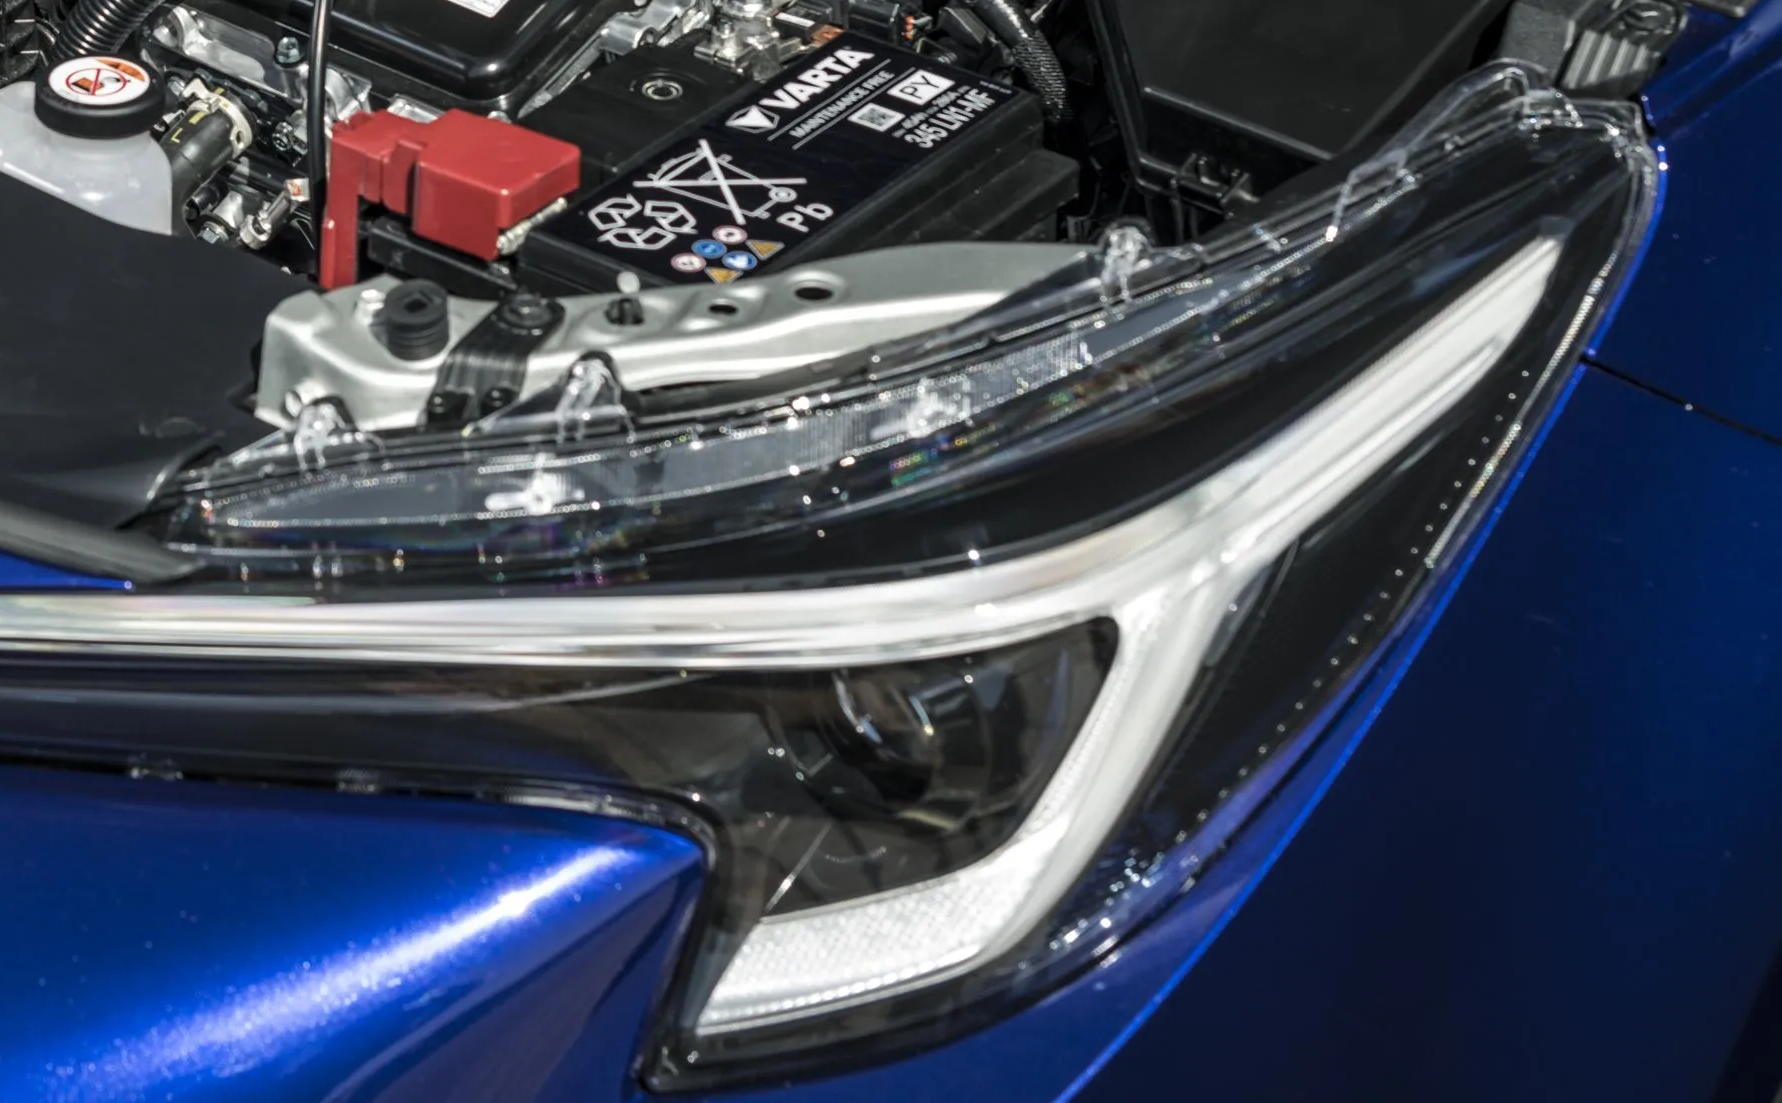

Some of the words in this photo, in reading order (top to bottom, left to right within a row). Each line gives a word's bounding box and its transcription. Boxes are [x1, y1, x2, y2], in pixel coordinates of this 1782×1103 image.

[758, 47, 876, 110] VARTA
[899, 74, 940, 100] PY
[788, 86, 870, 138] MAINTENANCE
[861, 69, 896, 91] FREE
[775, 202, 835, 234] Pb
